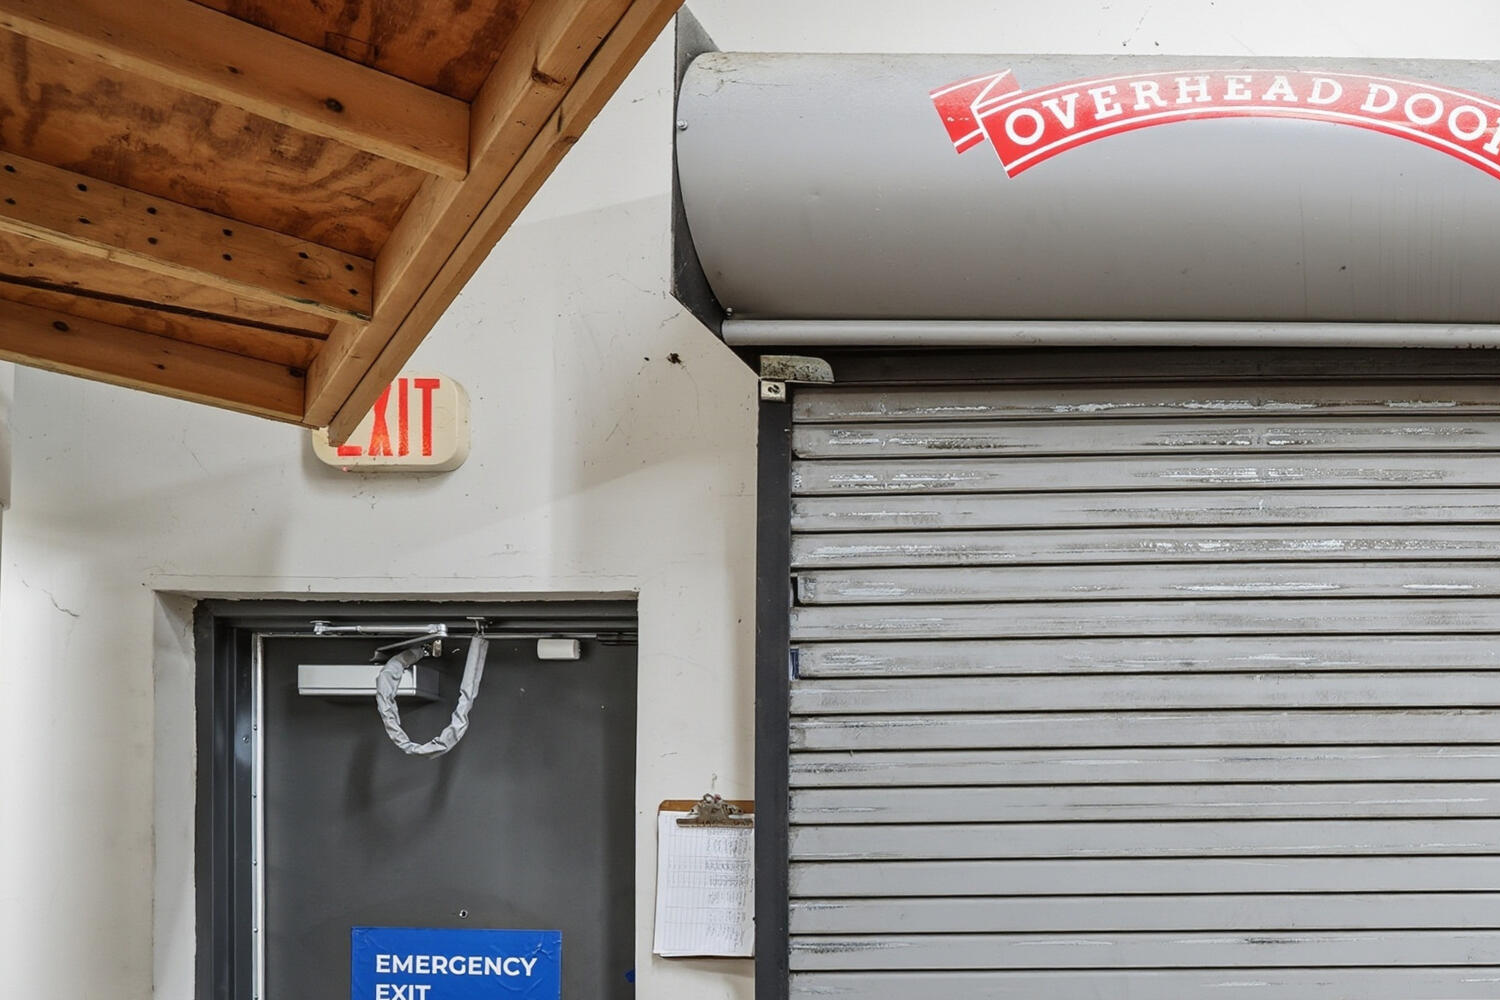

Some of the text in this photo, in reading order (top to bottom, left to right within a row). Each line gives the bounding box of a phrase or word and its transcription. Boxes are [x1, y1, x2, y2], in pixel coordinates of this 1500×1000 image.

[1005, 75, 1343, 146] OVERHEAD
[337, 378, 440, 456] XIT
[375, 954, 538, 977] EMERGENCY
